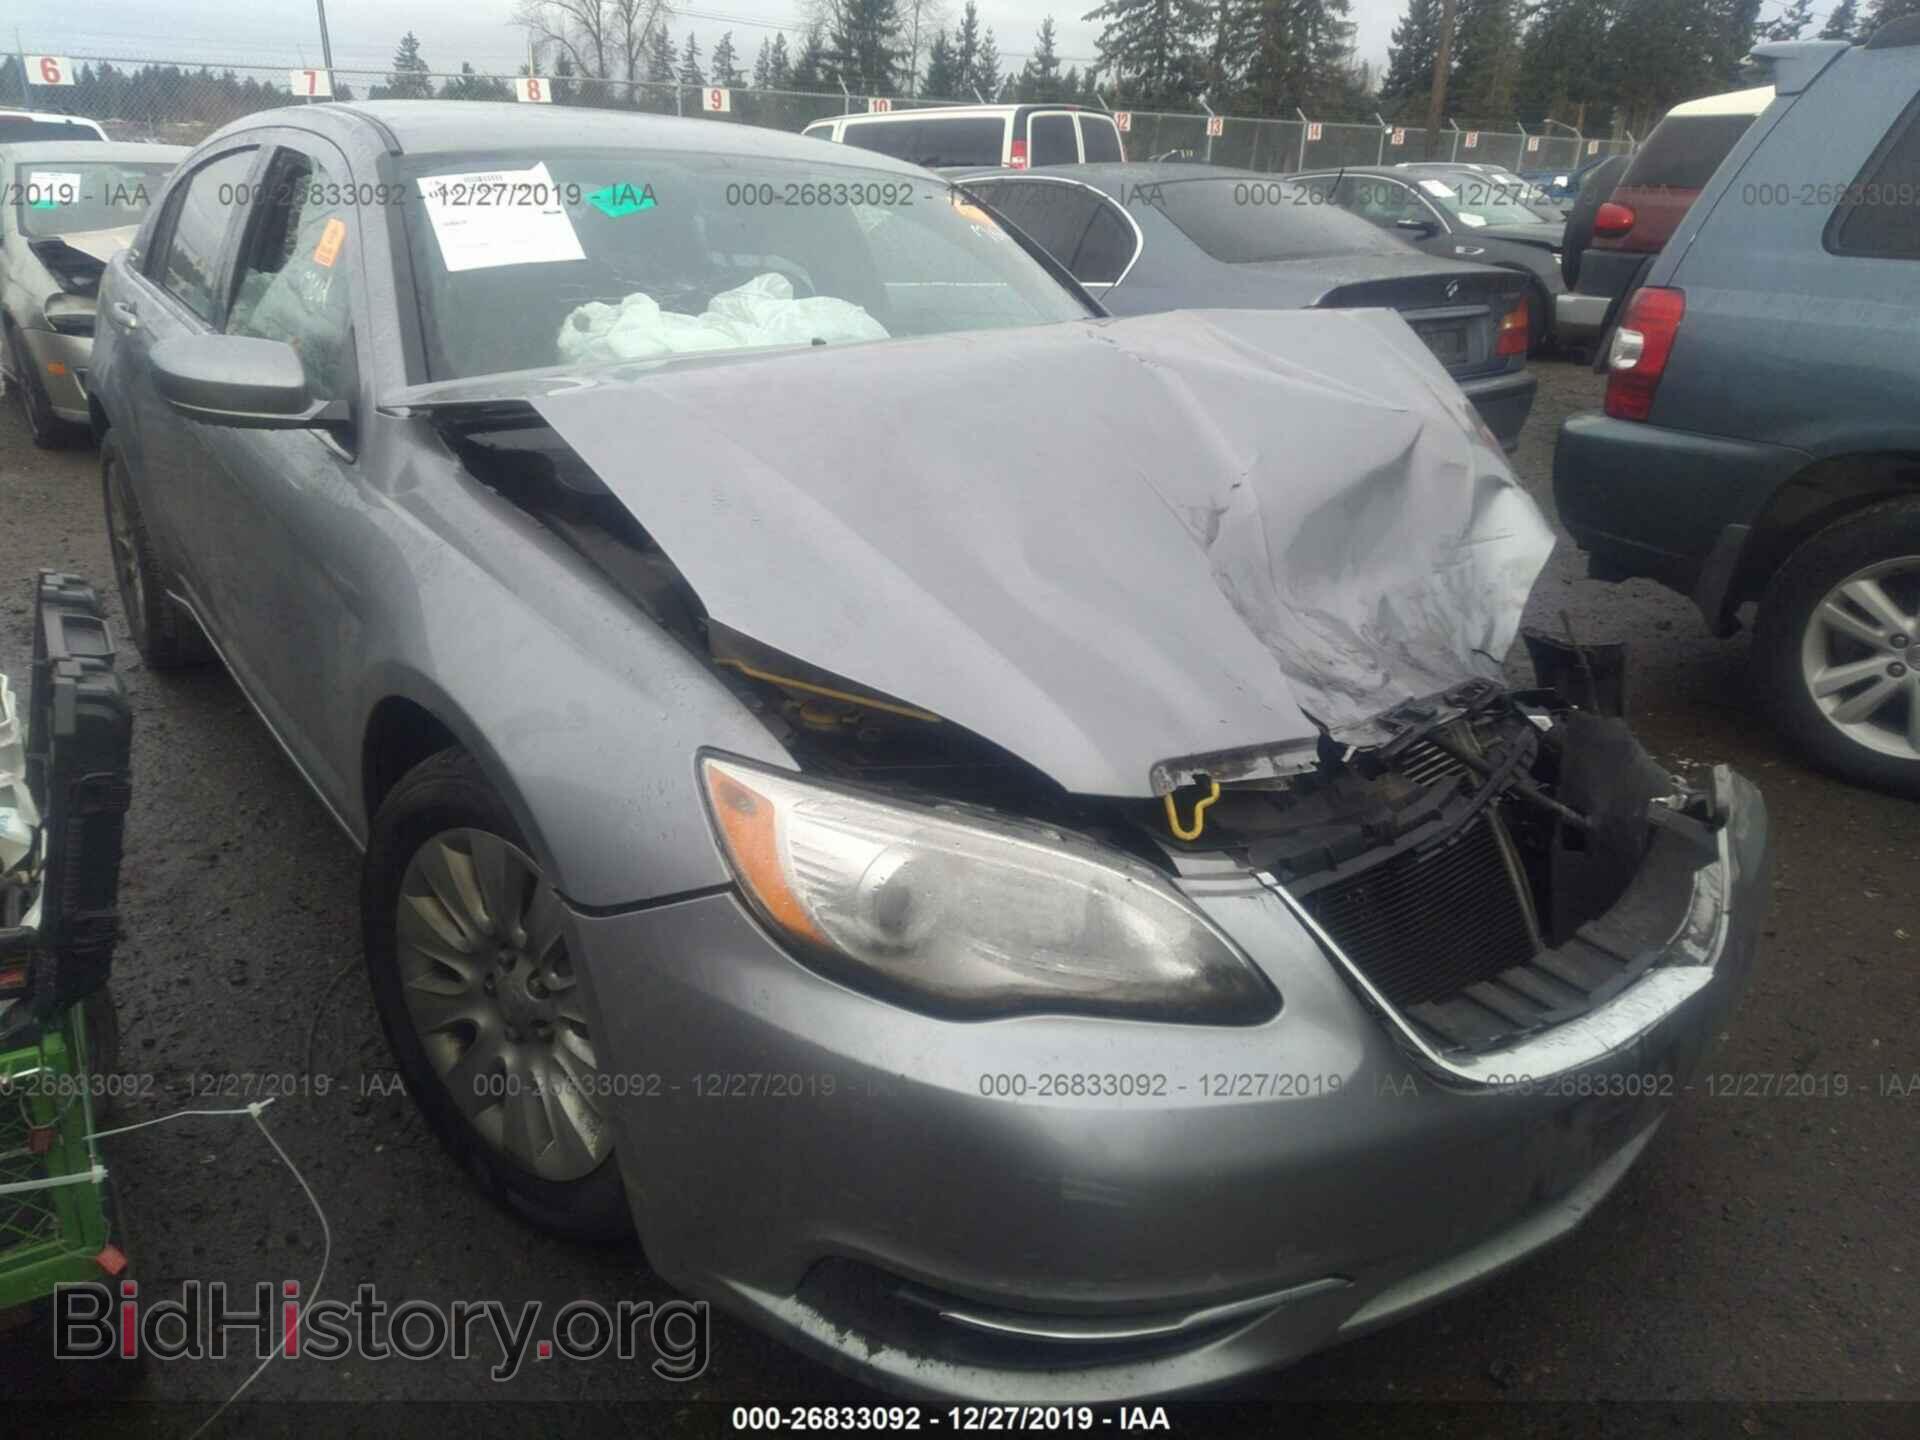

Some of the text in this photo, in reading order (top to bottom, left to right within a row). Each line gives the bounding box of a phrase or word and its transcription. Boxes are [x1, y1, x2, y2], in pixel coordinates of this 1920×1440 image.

[40, 58, 62, 83] 6
[303, 71, 316, 95] 7
[527, 80, 541, 101] 8
[711, 89, 722, 110] 9
[873, 99, 889, 112] 10
[1115, 112, 1128, 130] 12
